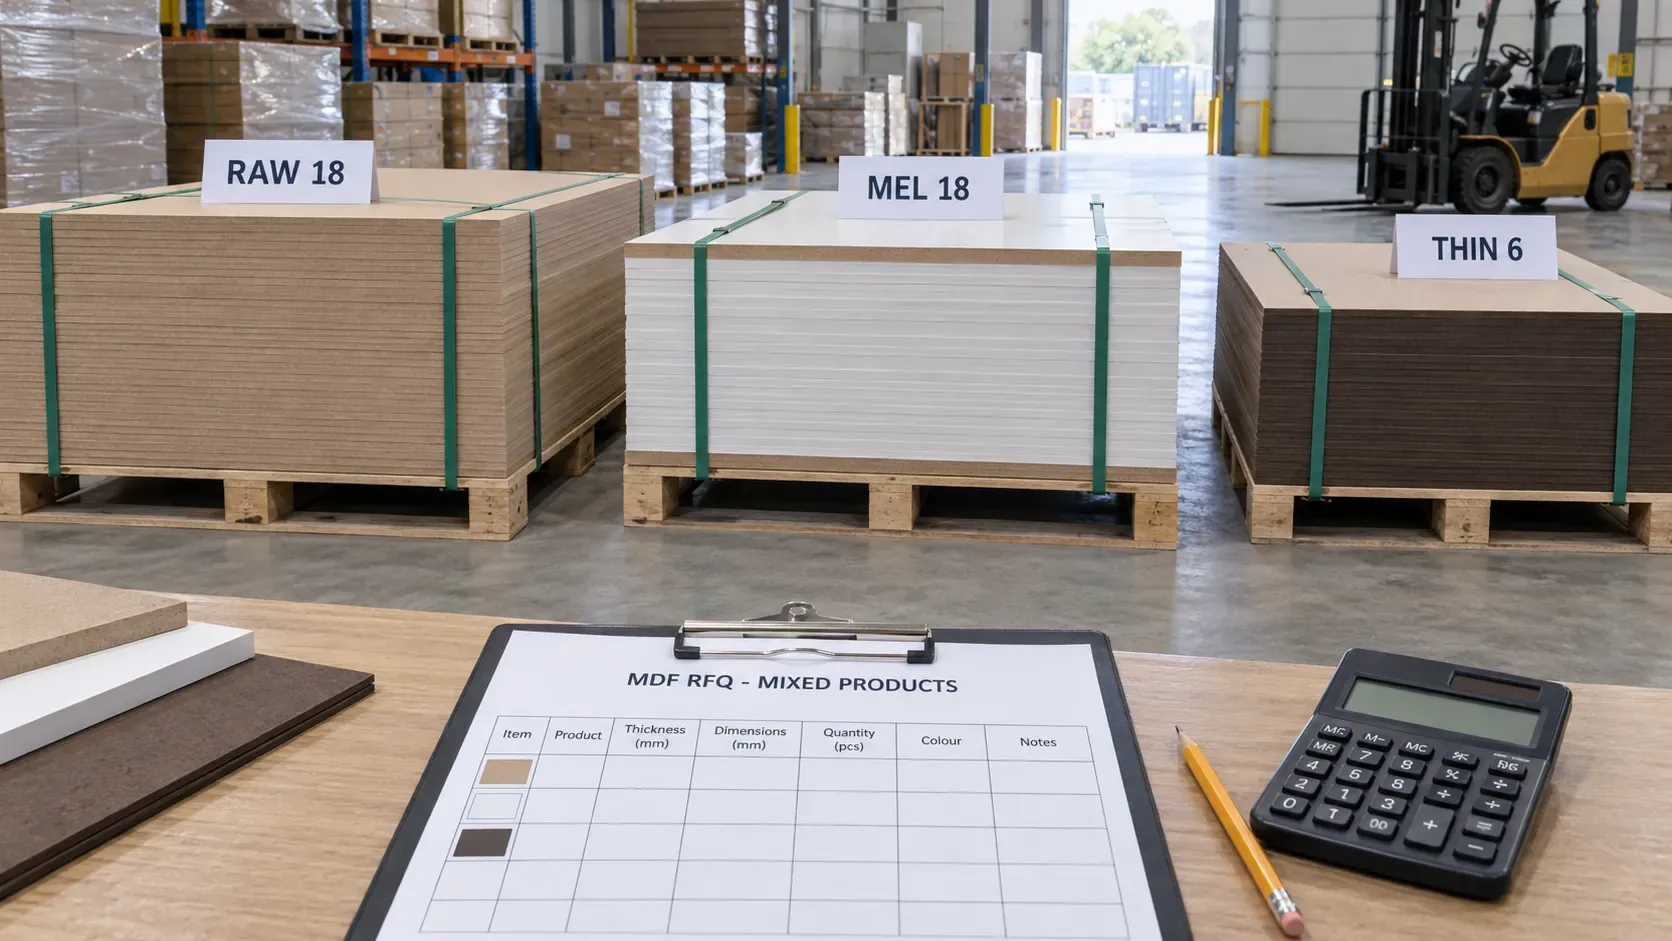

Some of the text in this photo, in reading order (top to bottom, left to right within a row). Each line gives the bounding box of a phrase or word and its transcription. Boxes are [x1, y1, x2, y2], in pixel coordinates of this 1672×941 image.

[228, 160, 344, 185] RAW 18
[869, 176, 969, 200] MEL 18
[1432, 237, 1522, 261] THIN 6
[627, 672, 680, 687] MDF
[687, 673, 734, 690] RFQ
[758, 675, 831, 690] MIXED
[839, 677, 958, 693] PRODUCTS
[502, 729, 532, 739] Item
[554, 730, 603, 740] Product
[624, 724, 686, 735] Thickness
[714, 725, 787, 736] Dimensions
[823, 727, 876, 740] Quantity
[635, 738, 669, 750] (mm)
[732, 739, 766, 751] (mm)
[921, 735, 962, 746] Colour
[1020, 737, 1057, 747] Notes
[834, 741, 864, 753] (pcs)
[1405, 742, 1428, 753] MC
[1360, 750, 1372, 760] 7
[1306, 760, 1320, 770] 4
[1400, 760, 1413, 770] 8
[1294, 778, 1308, 789] 2
[1283, 797, 1296, 809] 0
[1380, 798, 1395, 810] 3
